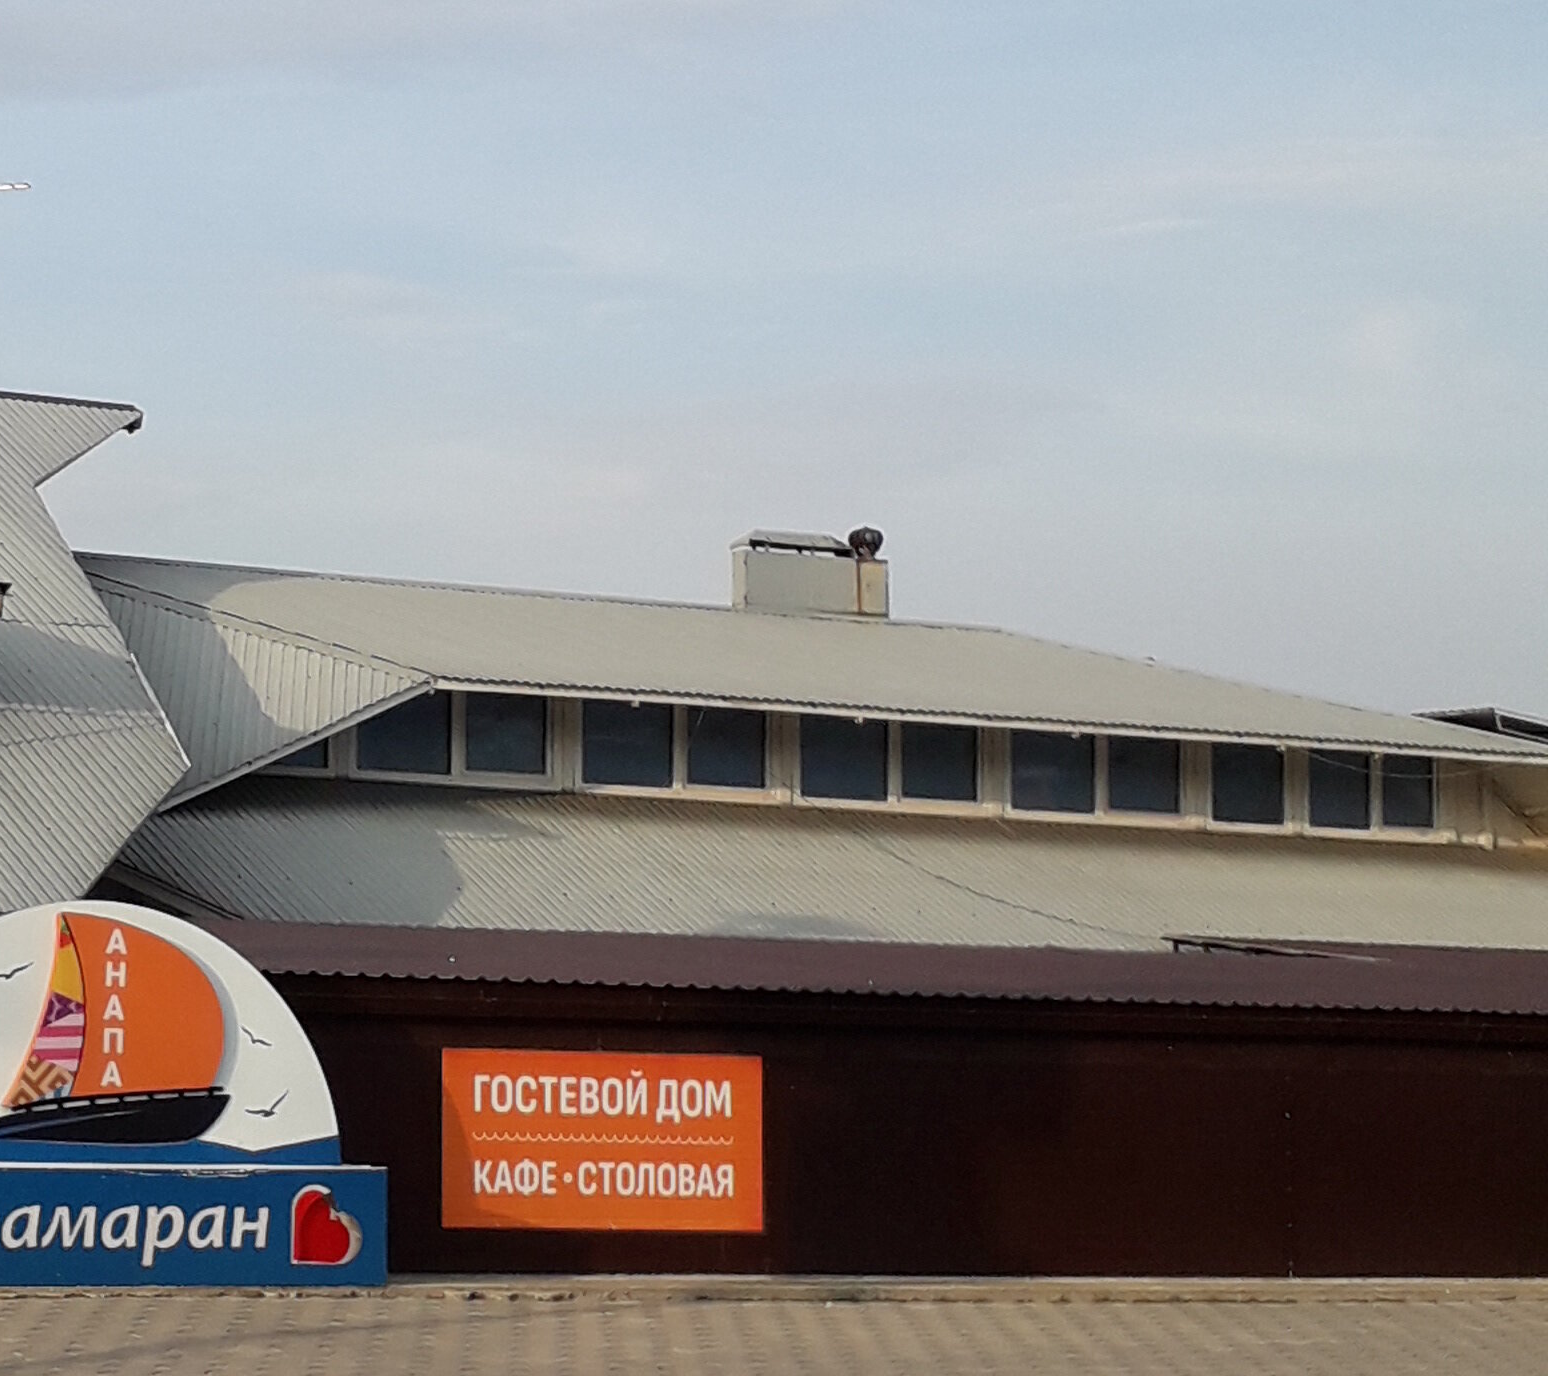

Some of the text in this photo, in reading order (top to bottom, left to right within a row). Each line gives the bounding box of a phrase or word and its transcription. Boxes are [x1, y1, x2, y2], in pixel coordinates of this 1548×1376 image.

[100, 927, 129, 1088] АНАПА
[473, 1069, 733, 1124] ГОСТЕВОЙ ДОМ
[474, 1158, 734, 1198] КАФЕ СТОЛОВАЯ
